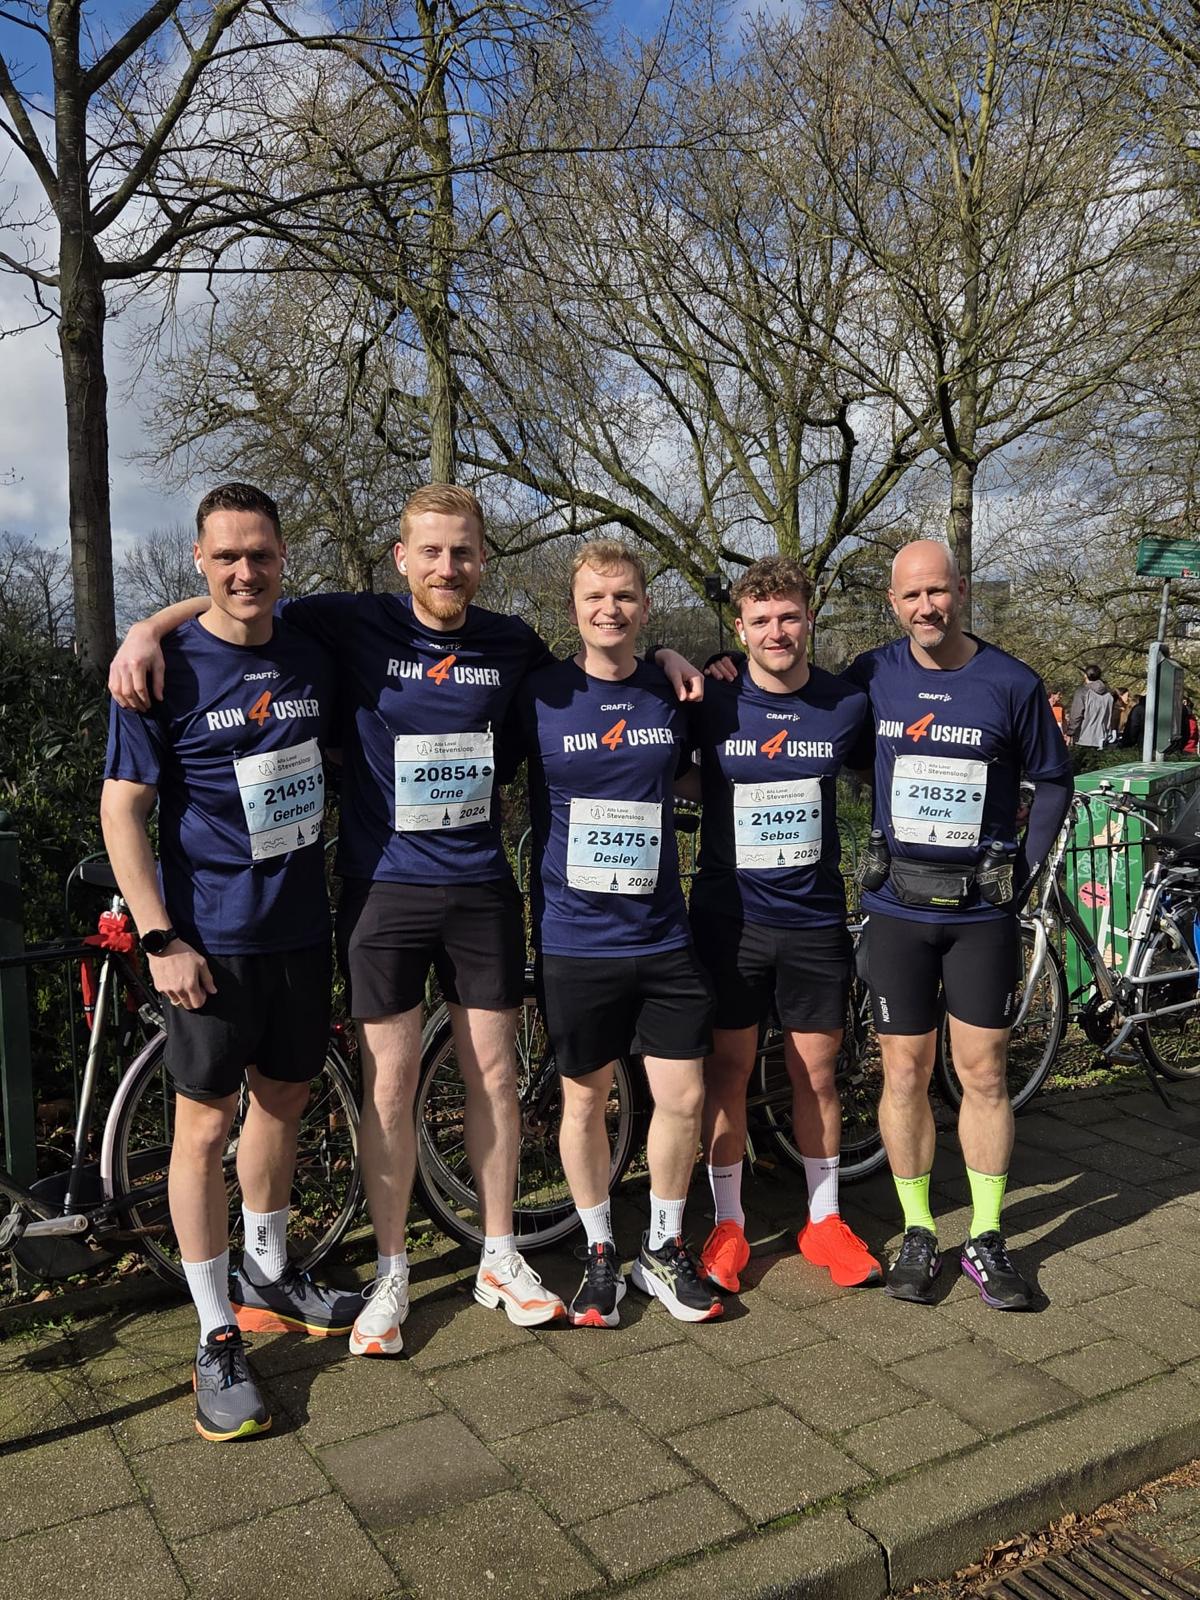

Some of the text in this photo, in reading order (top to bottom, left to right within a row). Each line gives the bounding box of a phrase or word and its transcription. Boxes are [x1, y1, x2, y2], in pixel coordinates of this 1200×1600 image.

[243, 671, 272, 681] CRAFT
[386, 654, 501, 686] RUN 4 USHER
[918, 692, 944, 700] CRAFT
[206, 690, 320, 731] RUN 4 USHER
[600, 704, 627, 712] CRAFT
[563, 718, 675, 753] RUN 4 USHER
[878, 712, 983, 746] RUN 4 USHER
[435, 746, 474, 754] Stevensloop
[725, 729, 834, 759] RUN 4 USHER
[414, 765, 479, 782] 20854
[264, 776, 315, 805] 21493
[430, 788, 463, 799] Orne
[908, 784, 967, 803] 21832
[273, 801, 315, 822] Gerben
[459, 806, 486, 819] 2026
[751, 809, 807, 826] 21492
[918, 805, 953, 818] Mark
[587, 830, 646, 847] 23475
[760, 831, 800, 841] Sebas
[945, 830, 975, 840] 2026
[593, 852, 639, 867] Desley
[793, 848, 819, 860] 2026
[627, 877, 654, 887] 2026
[878, 996, 890, 1022] FUSION
